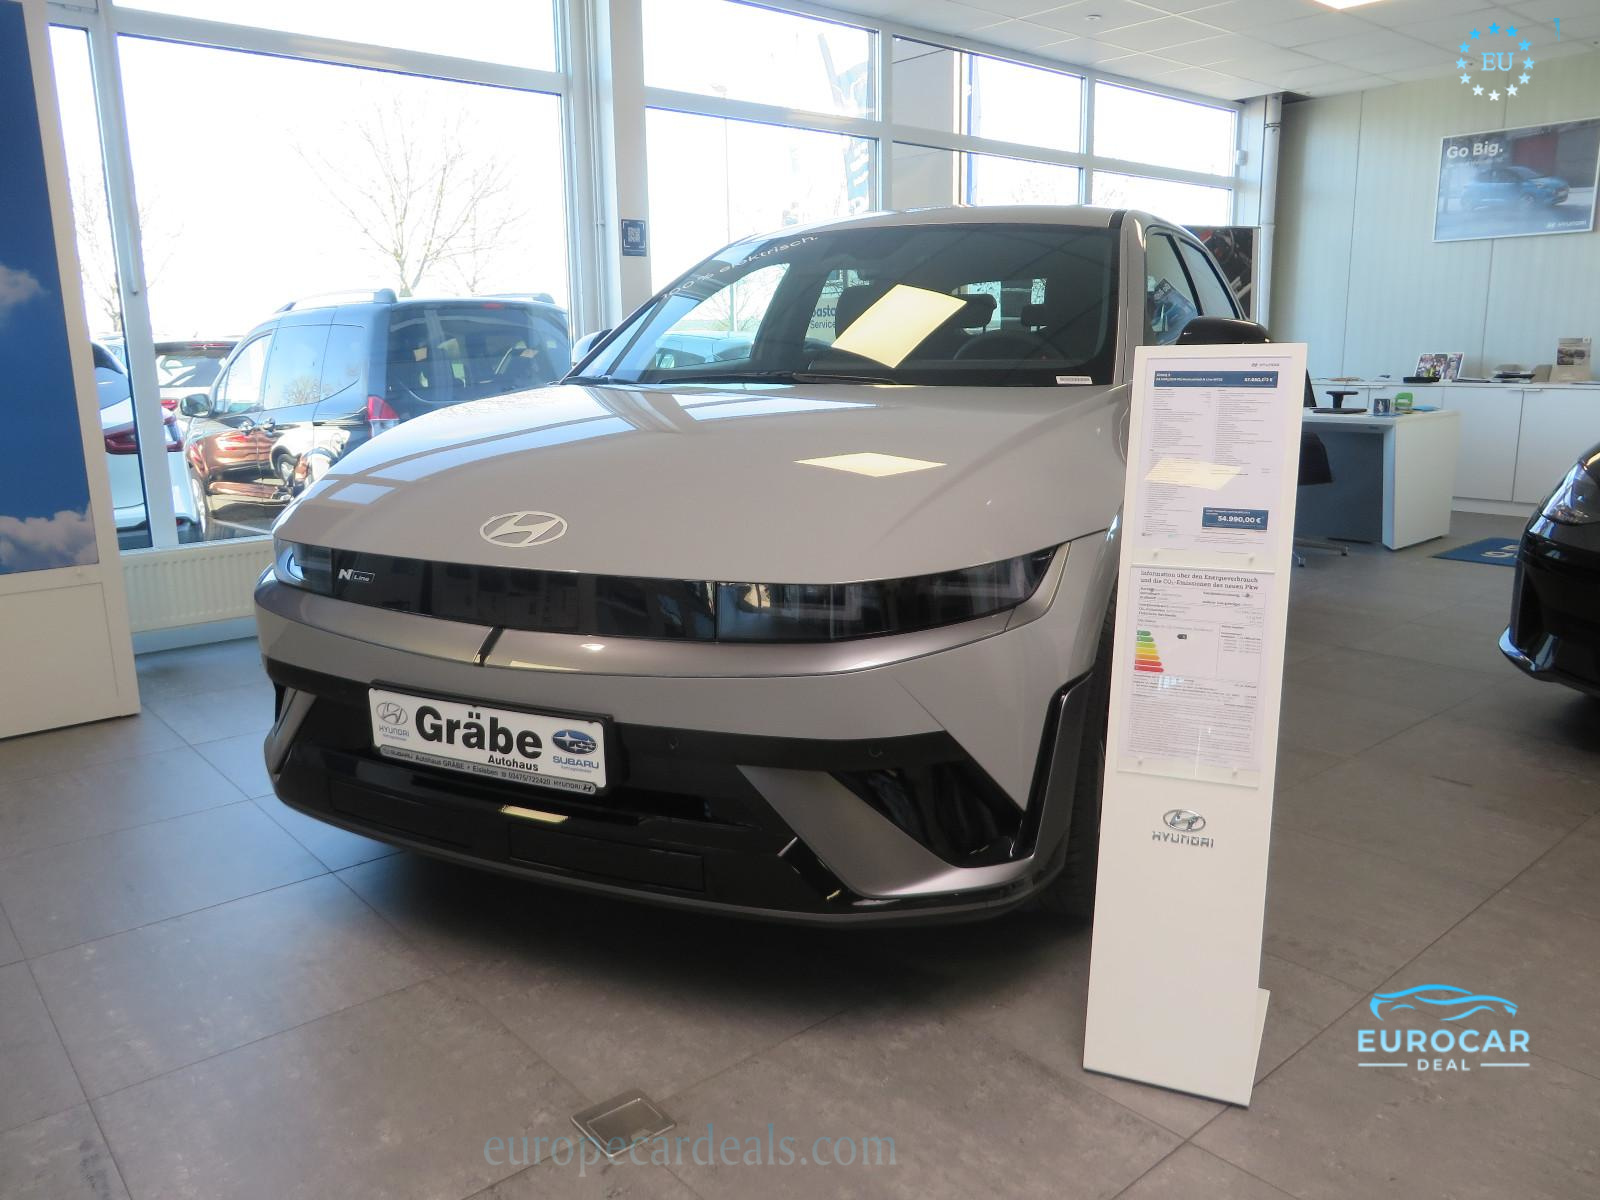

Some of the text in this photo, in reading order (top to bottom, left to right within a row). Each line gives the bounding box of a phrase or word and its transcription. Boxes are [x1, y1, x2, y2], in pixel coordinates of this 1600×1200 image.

[1447, 140, 1504, 159] Go Big.
[1217, 514, 1255, 525] 54.990,00
[338, 568, 354, 580] N
[378, 725, 410, 738] HYUNDAI
[415, 704, 543, 760] Gräbe
[487, 754, 539, 772] Autohaus
[552, 755, 600, 769] SUBARU
[1151, 830, 1215, 849] HYUNDAI
